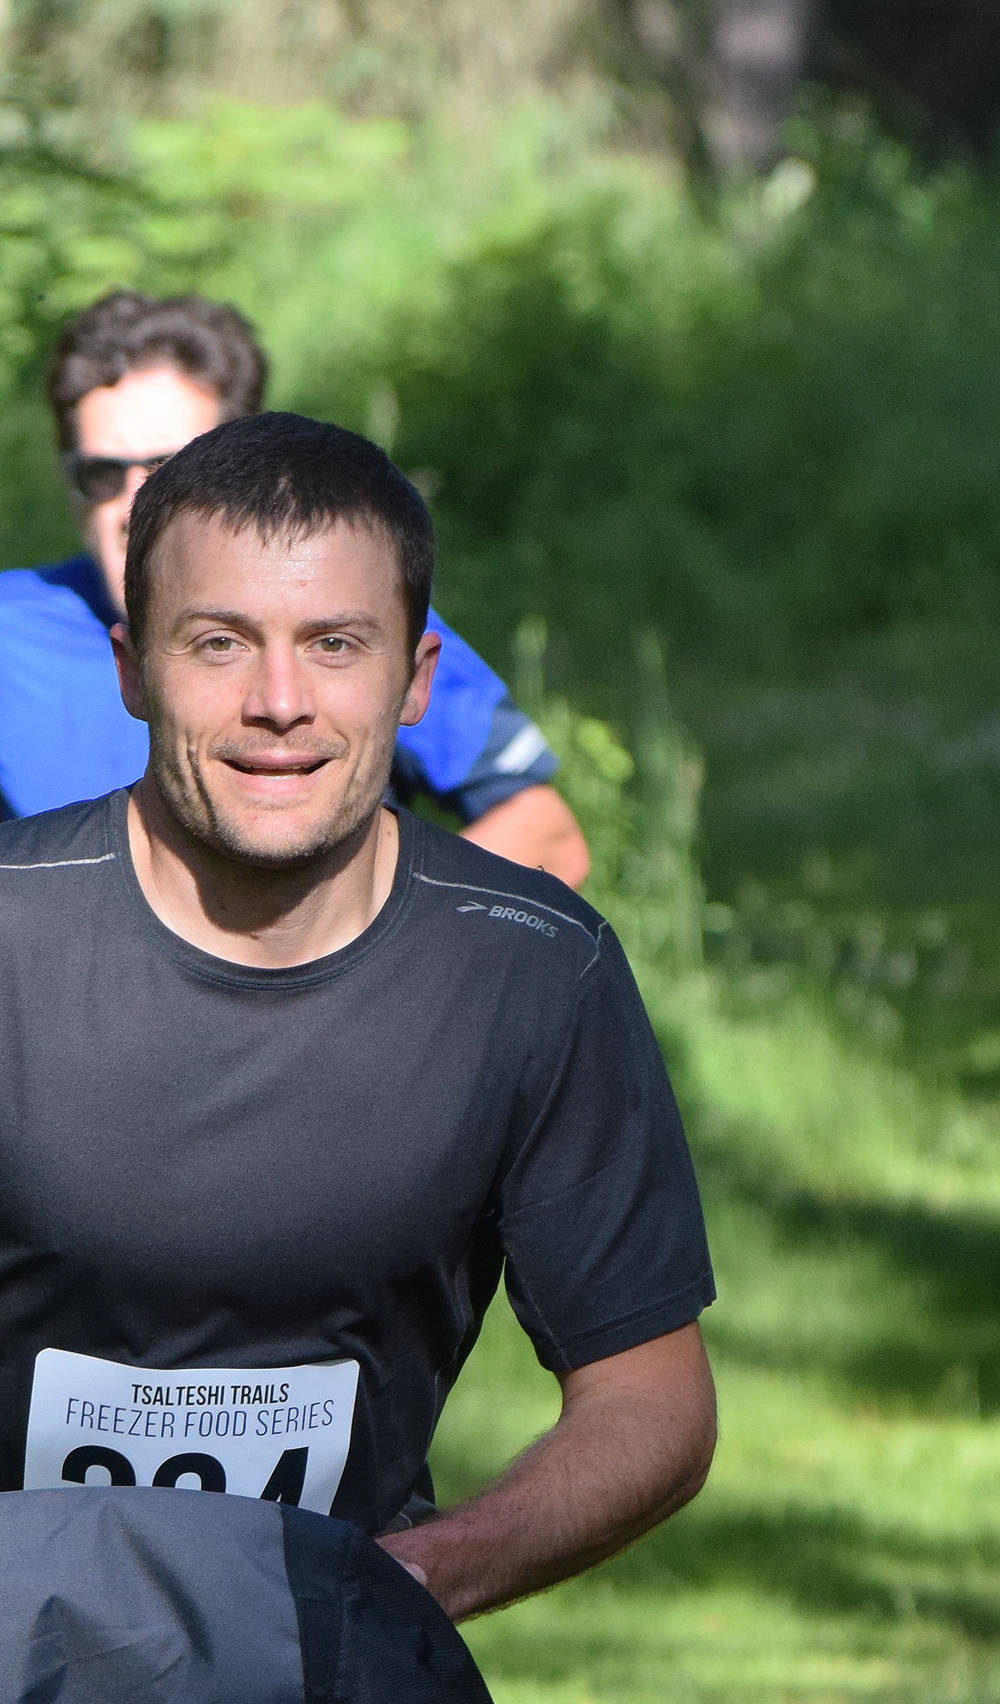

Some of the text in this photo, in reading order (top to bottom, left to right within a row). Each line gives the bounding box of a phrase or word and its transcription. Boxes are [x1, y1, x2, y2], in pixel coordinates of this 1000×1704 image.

[488, 905, 559, 938] BROOKS
[131, 1383, 290, 1406] TSALTESHI TRAILS
[65, 1397, 335, 1438] FREEZER FOOD SERIES
